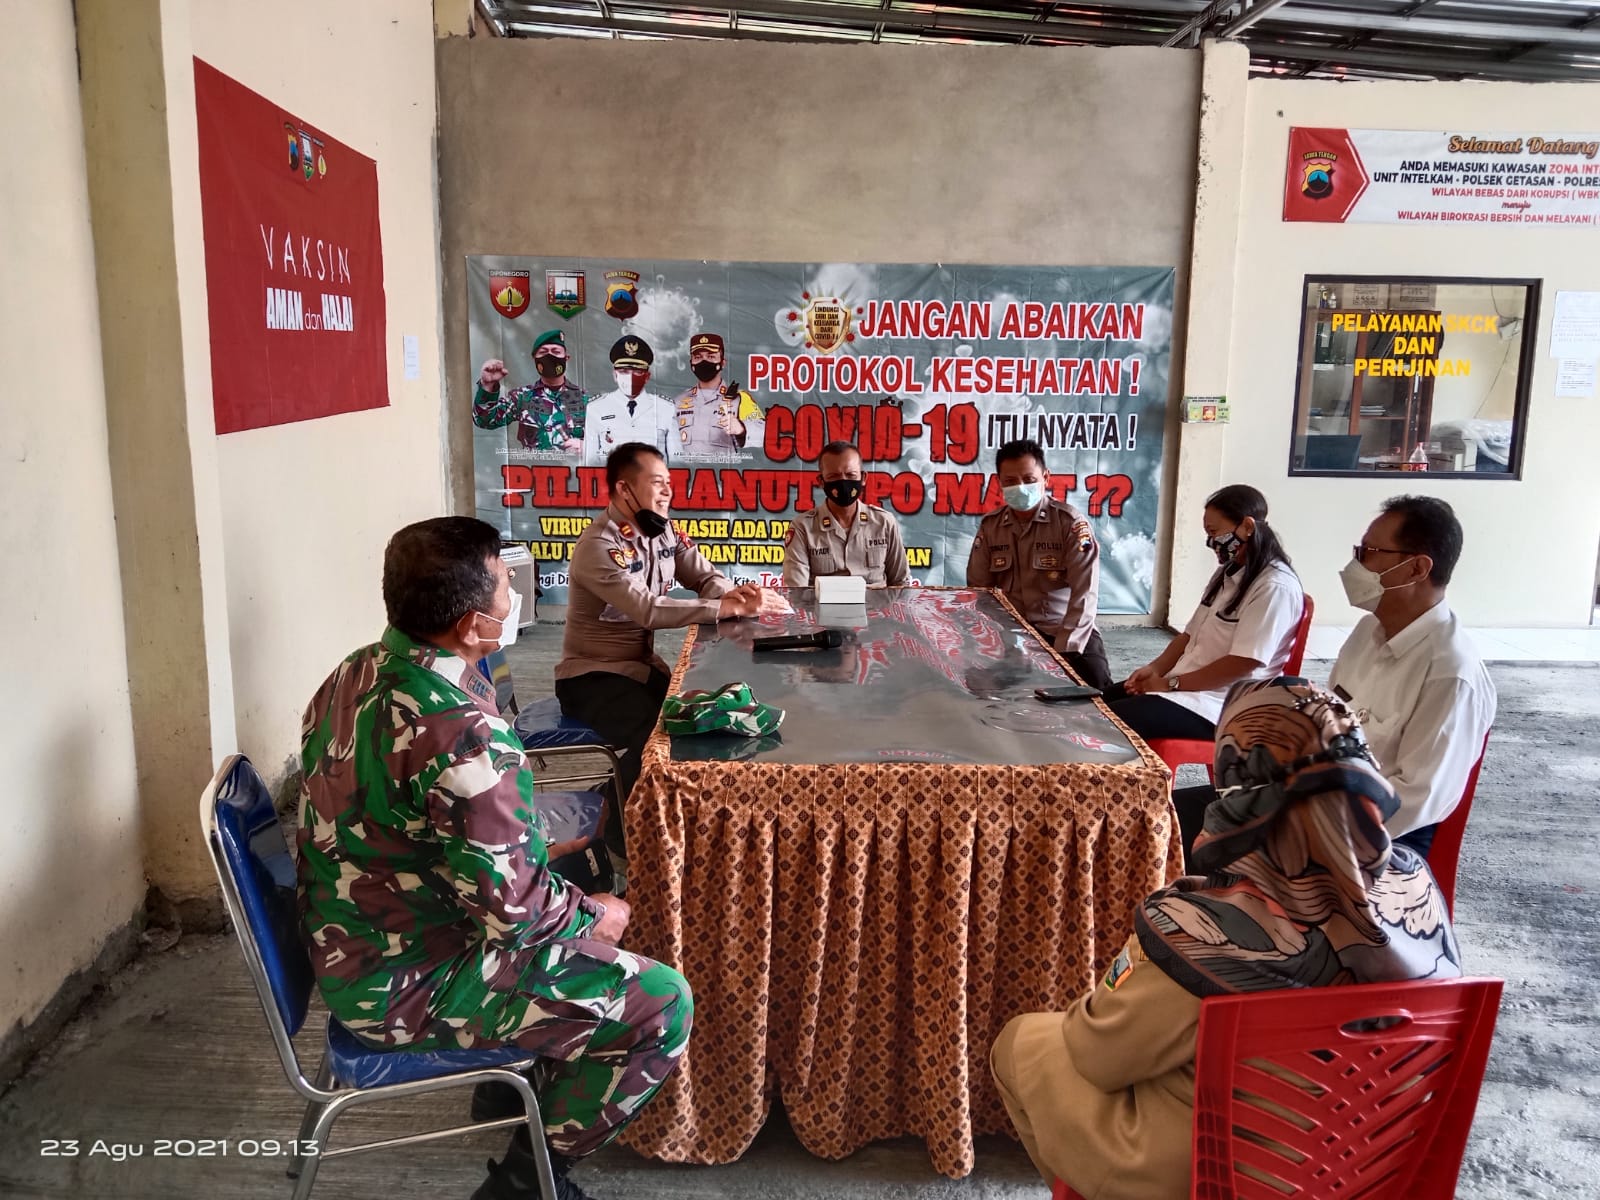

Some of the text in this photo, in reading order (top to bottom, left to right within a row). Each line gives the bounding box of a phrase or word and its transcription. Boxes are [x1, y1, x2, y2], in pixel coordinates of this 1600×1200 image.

[1448, 136, 1599, 159] Selamat Datang
[1400, 161, 1430, 171] ANDA
[1433, 161, 1489, 173] MEMASUKI
[1492, 163, 1547, 174] KAWASAN
[1549, 163, 1579, 174] ZONA
[1374, 172, 1399, 183] UNIT
[1400, 172, 1453, 184] INTELKAM
[1462, 175, 1503, 185] POLSEK
[1505, 176, 1555, 186] GETASAN
[1431, 187, 1473, 197] WILAYAH
[1475, 188, 1504, 198] BEBAS
[1506, 188, 1529, 199] DARI
[1530, 189, 1569, 199] KORUPSI
[1398, 210, 1439, 220] WILAYAH
[1441, 211, 1489, 221] BIROKRASI
[1490, 213, 1522, 222] BERSIH
[1524, 214, 1543, 222] DAN
[1546, 214, 1591, 224] MELAYANI
[260, 223, 351, 285] VAKSIN
[266, 287, 304, 330] AMAN
[304, 307, 323, 330] dan
[858, 300, 1145, 340] JANGAN ABAIKAN
[1332, 313, 1499, 335] PELAYANAN SKCK
[1394, 336, 1435, 355] DAN
[748, 354, 1140, 395] PROTOKOL KESEHATAN !
[1354, 358, 1471, 377] PERIJINAN
[764, 402, 1138, 465] COVID-19 ITU NYATA !
[1084, 473, 1134, 518] ??
[731, 520, 768, 540] ADA
